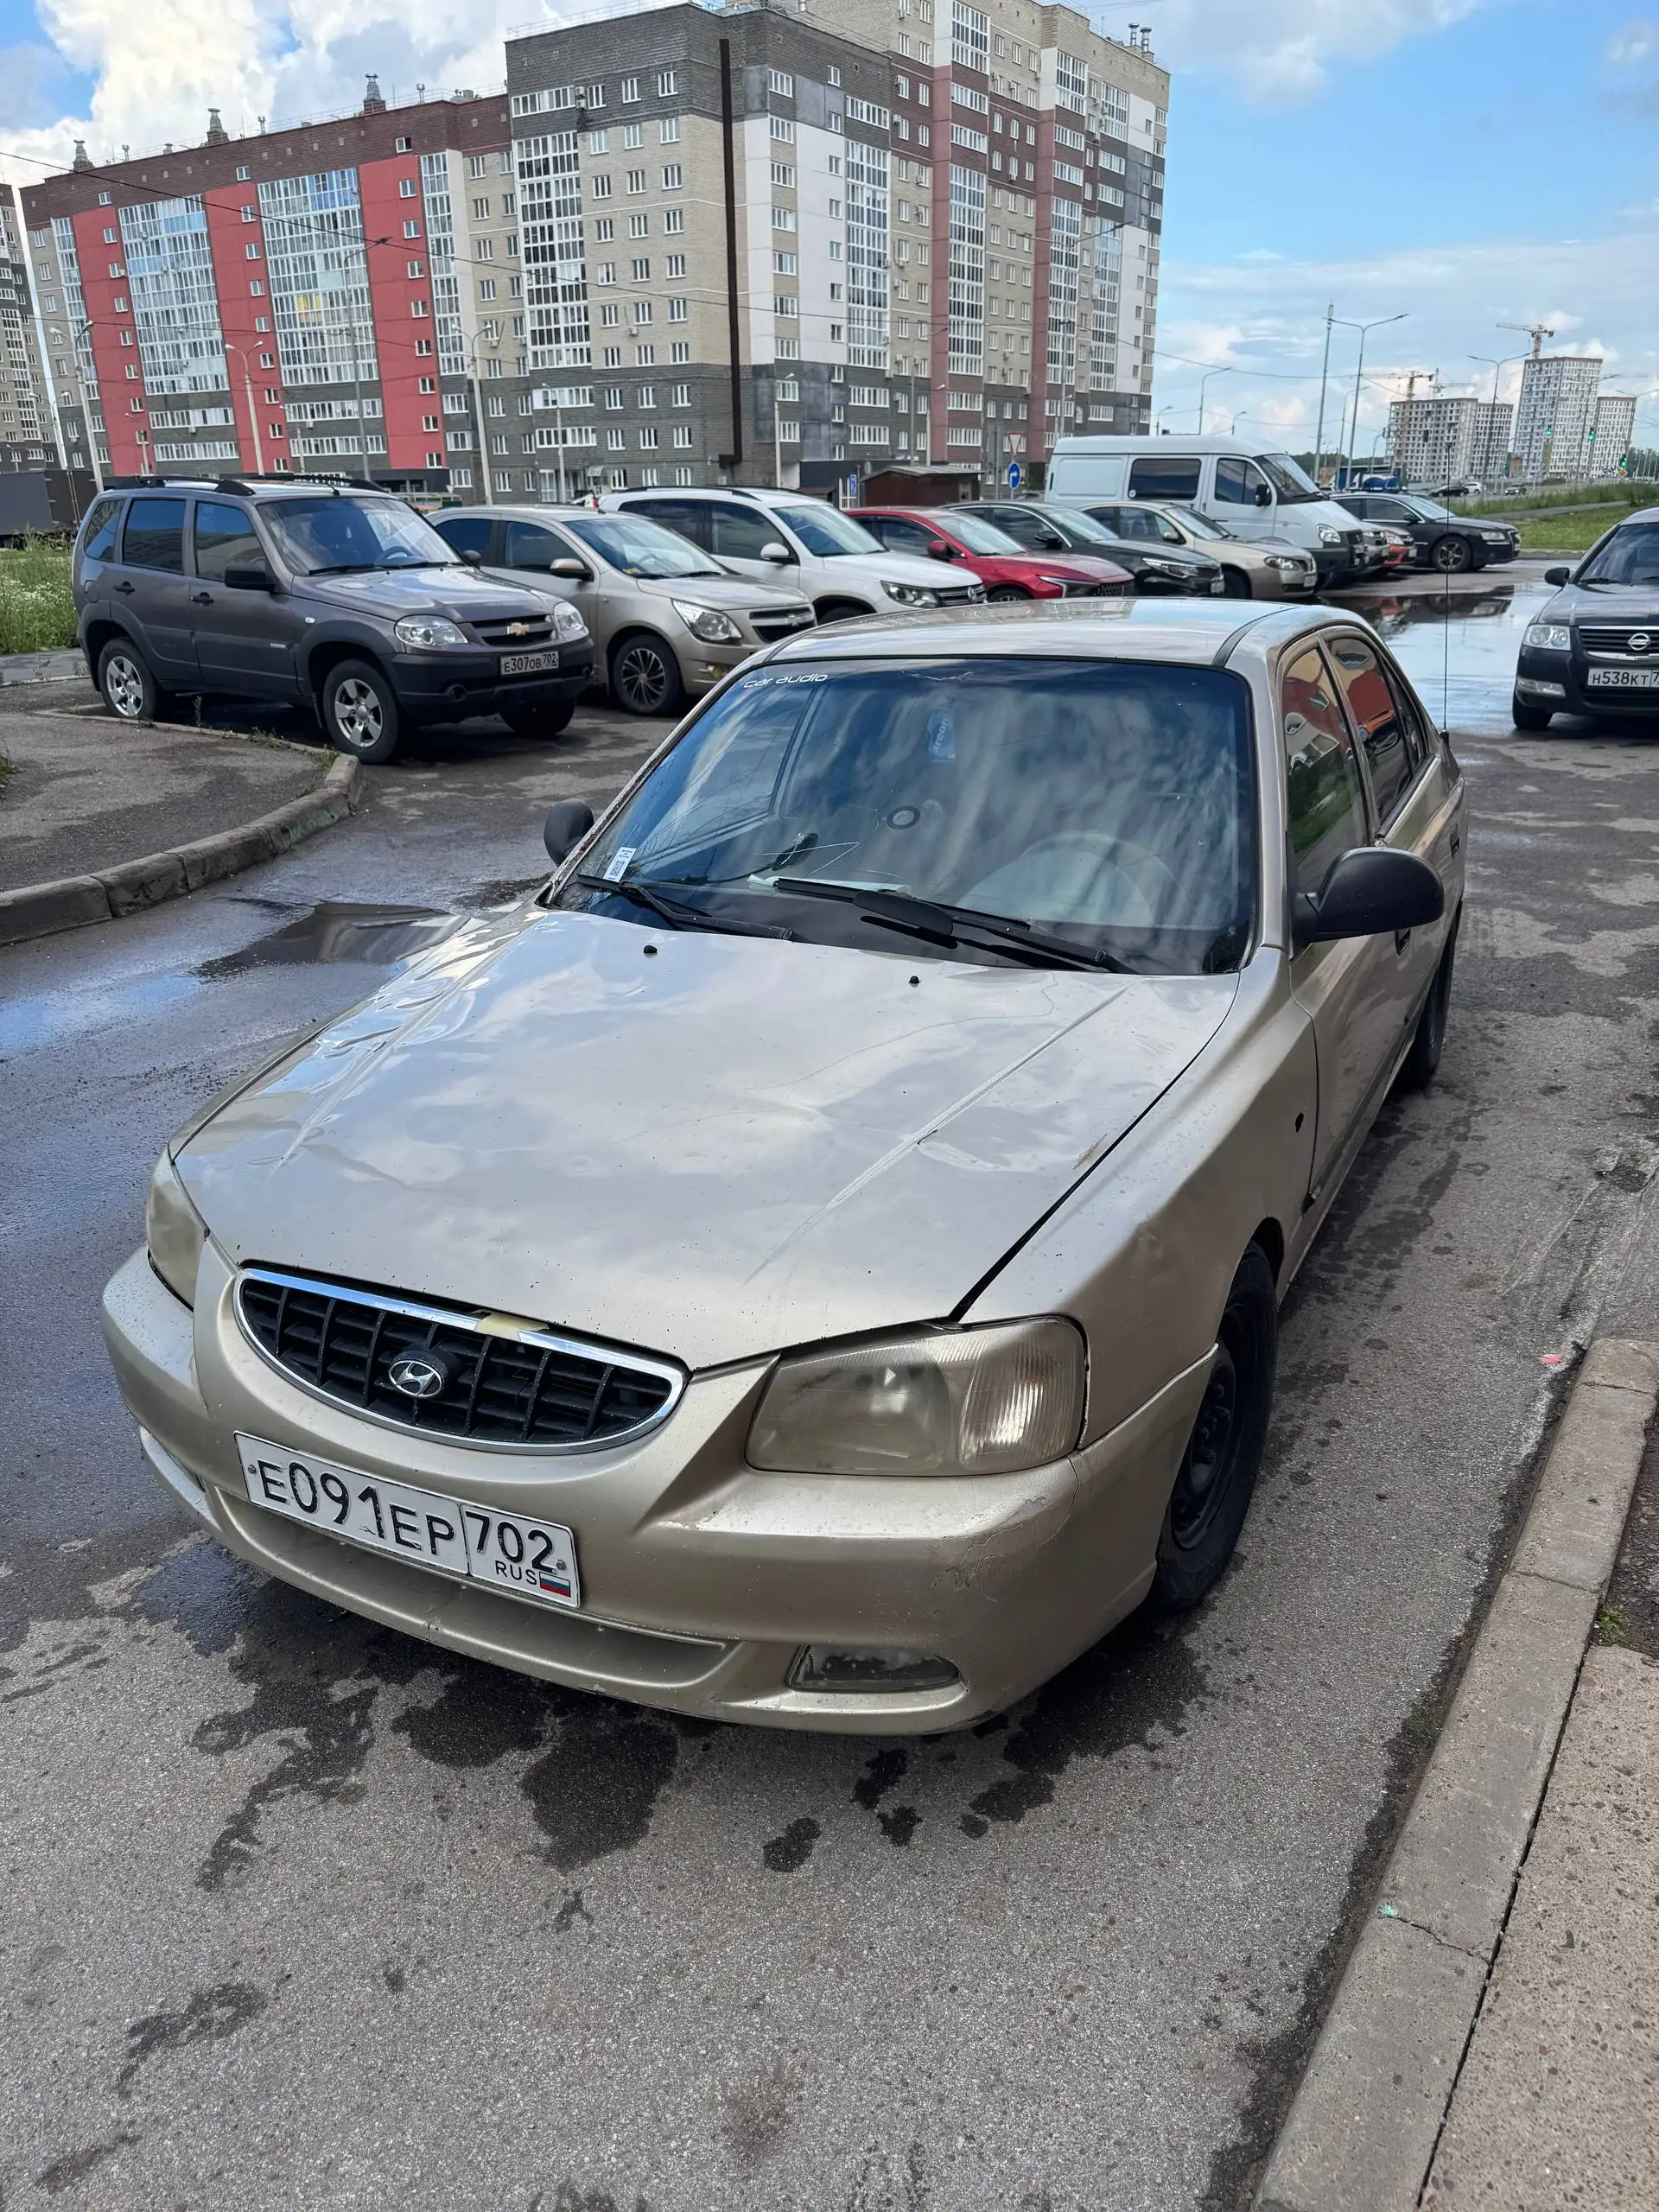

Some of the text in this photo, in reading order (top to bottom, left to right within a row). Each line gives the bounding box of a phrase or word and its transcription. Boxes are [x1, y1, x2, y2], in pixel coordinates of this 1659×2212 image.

[504, 653, 556, 672] Е307ОВ 702
[743, 673, 828, 689] car audio
[1592, 671, 1659, 685] Н538КТ 7
[257, 1459, 557, 1574] Е091ЕР 702
[494, 1560, 537, 1586] RUS
